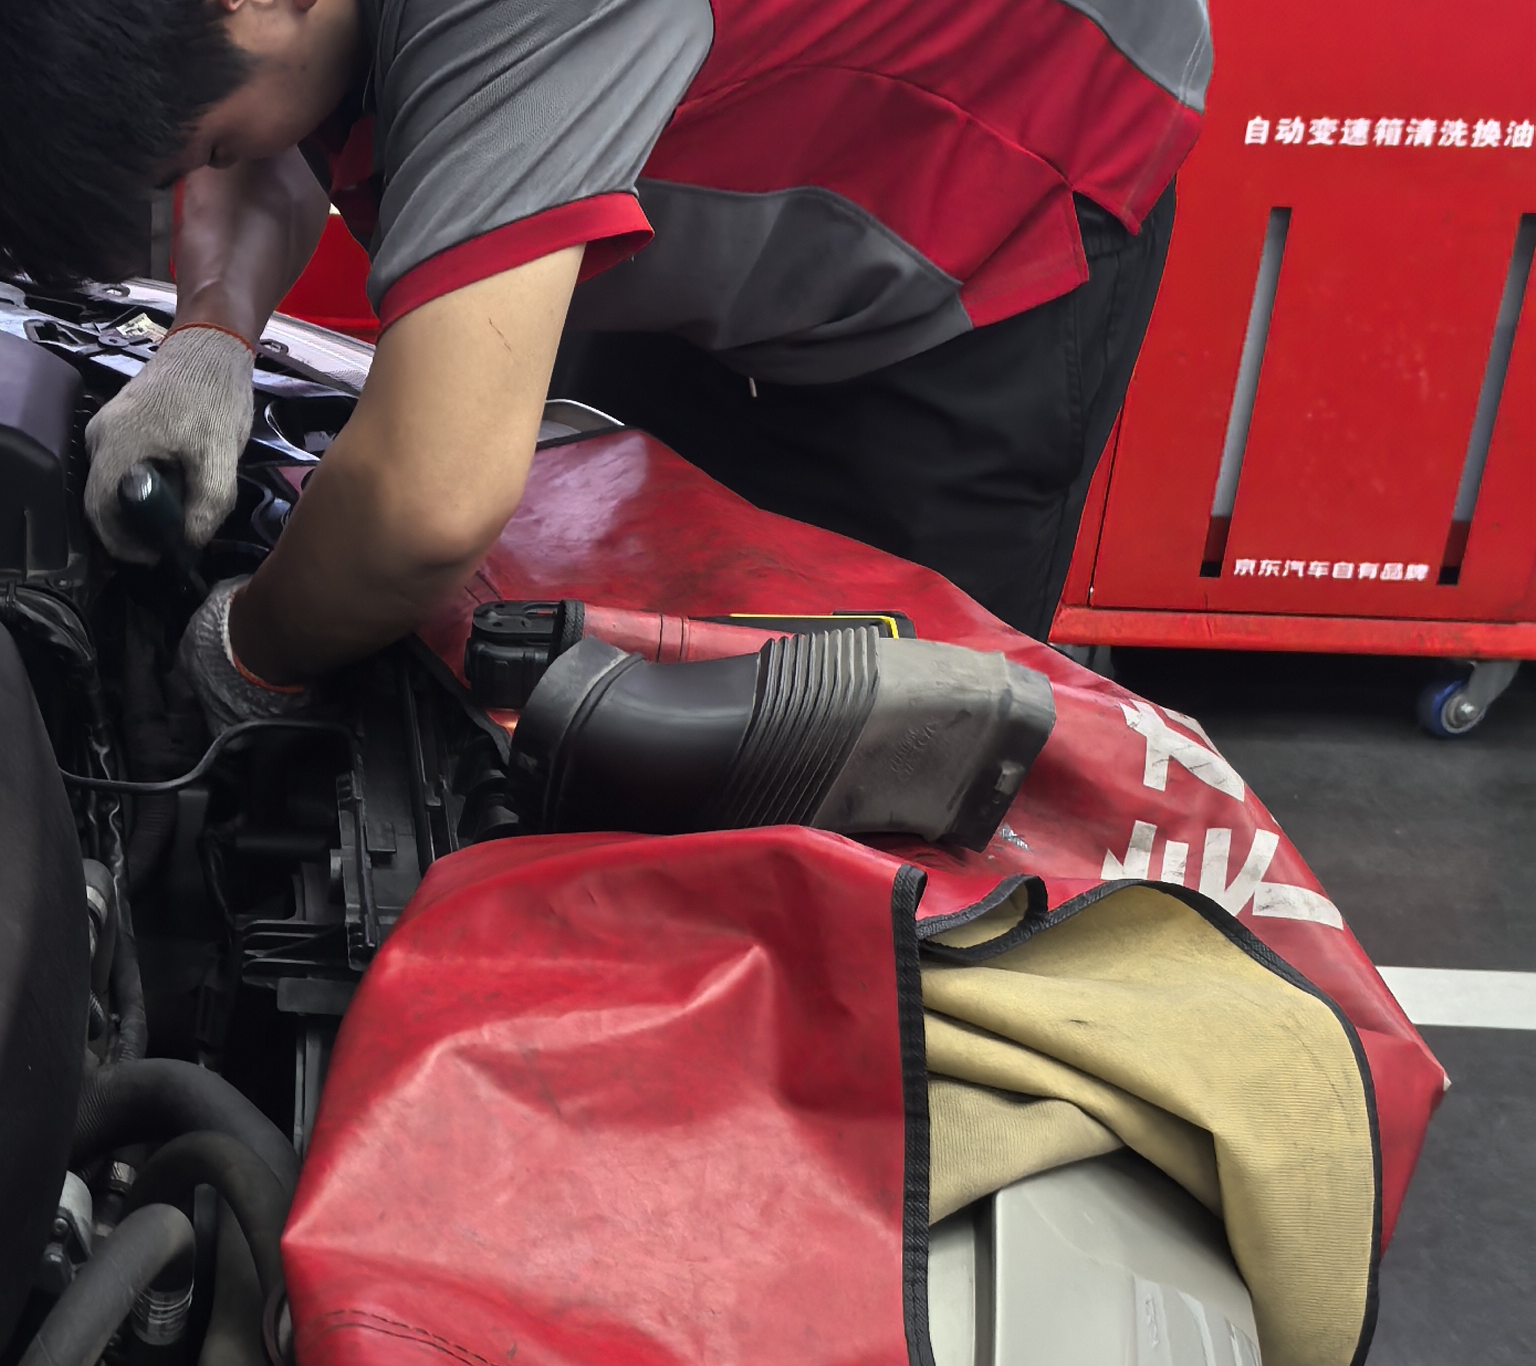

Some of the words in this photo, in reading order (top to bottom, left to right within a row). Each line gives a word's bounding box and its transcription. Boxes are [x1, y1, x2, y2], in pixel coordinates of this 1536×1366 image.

[1233, 558, 1429, 581] 京东汽车自有品牌
